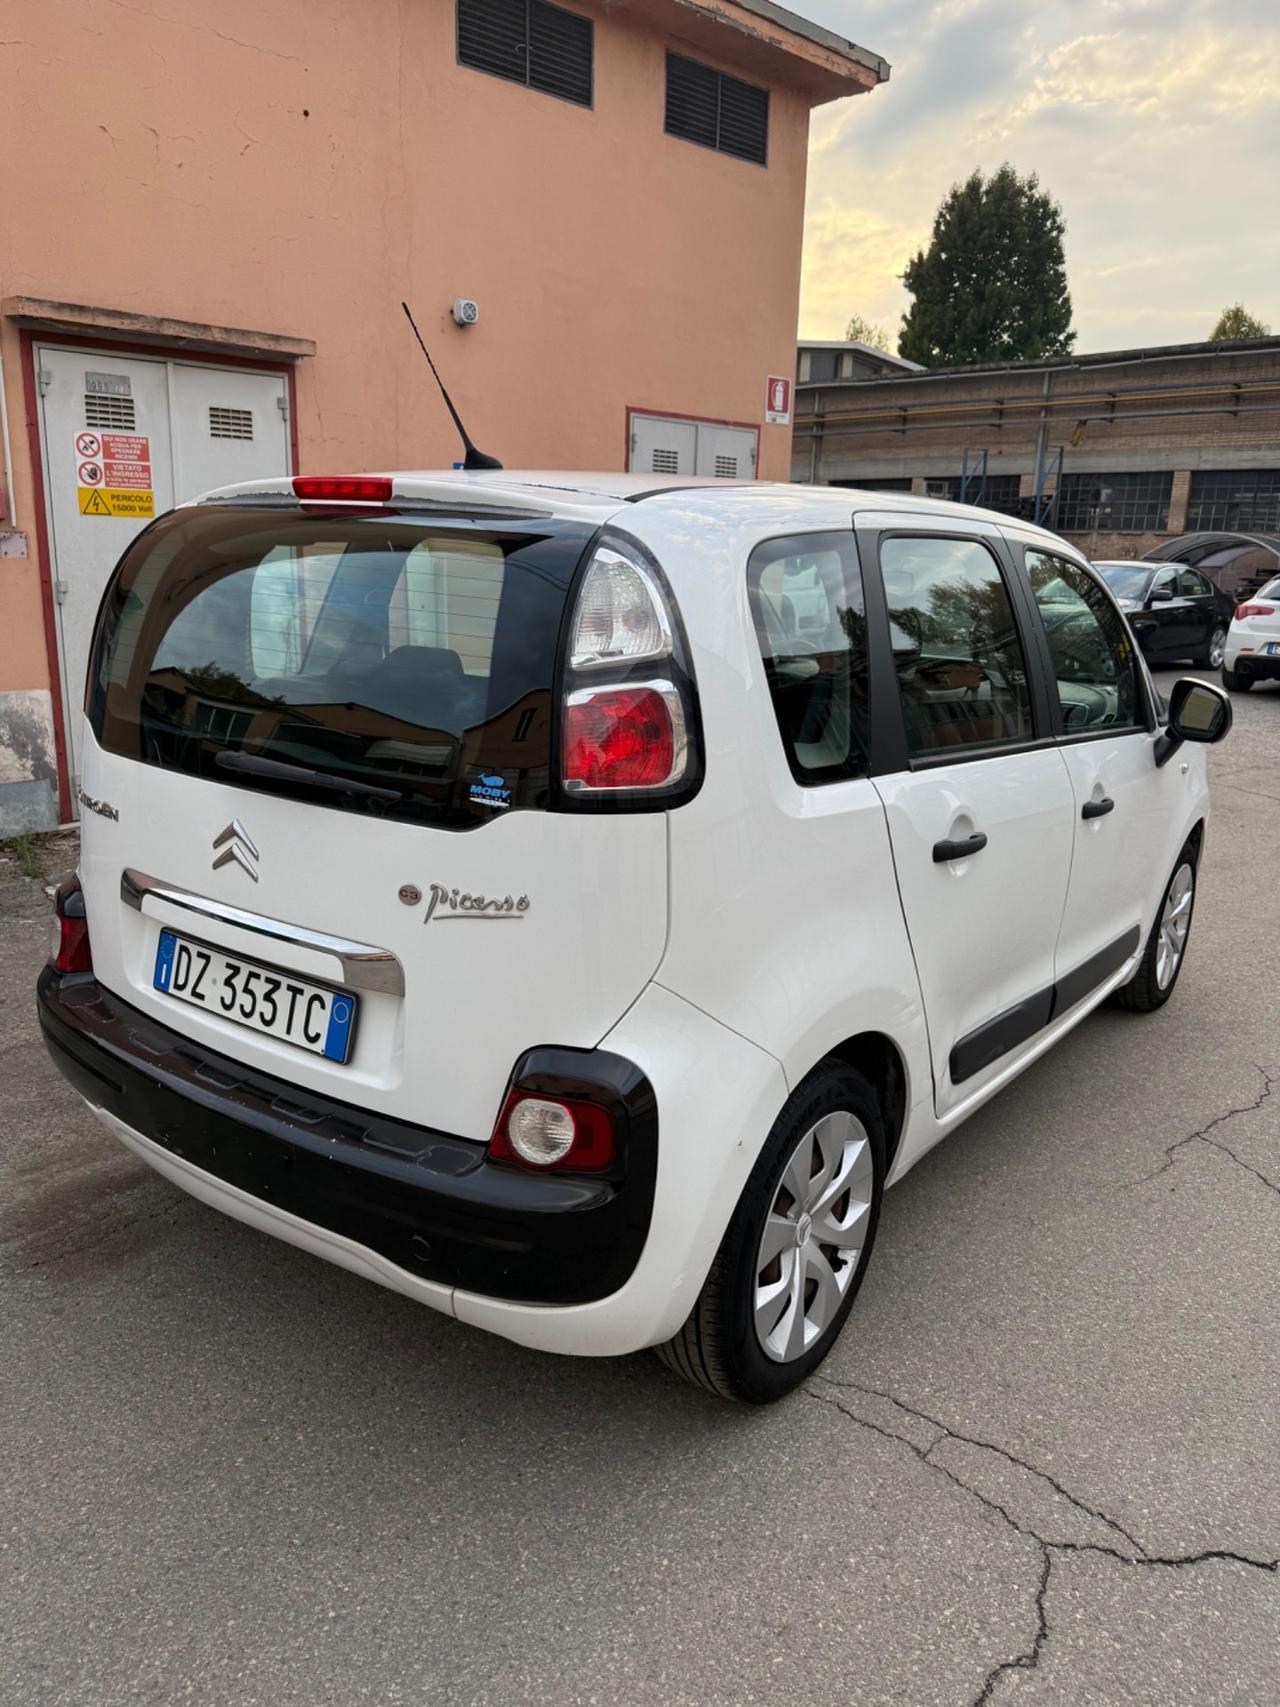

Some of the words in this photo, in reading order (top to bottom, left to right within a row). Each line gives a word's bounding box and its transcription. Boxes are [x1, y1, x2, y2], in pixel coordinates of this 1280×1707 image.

[112, 463, 142, 472] VIETATO
[110, 494, 152, 503] PERICOLO
[112, 504, 136, 512] 15000
[470, 785, 510, 798] MOBY
[172, 944, 211, 1001] DZ
[220, 961, 326, 1045] 353TC
